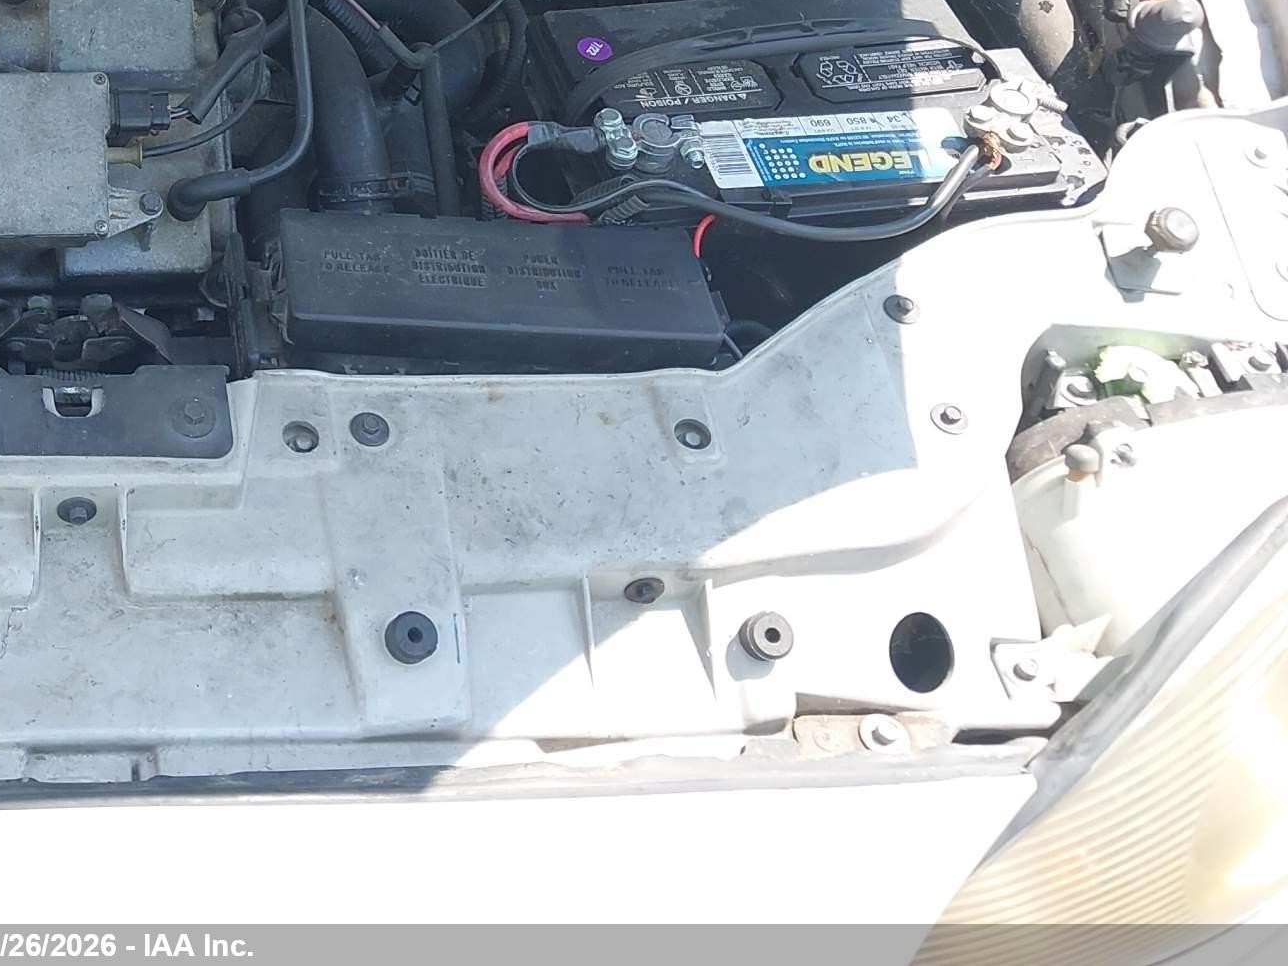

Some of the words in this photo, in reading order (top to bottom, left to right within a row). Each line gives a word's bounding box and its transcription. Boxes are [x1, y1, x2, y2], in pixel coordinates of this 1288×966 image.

[640, 98, 680, 108] POISON
[692, 94, 737, 104] DANGER
[846, 116, 867, 125] 850
[886, 115, 901, 123] 34
[808, 147, 930, 174] LEGEND
